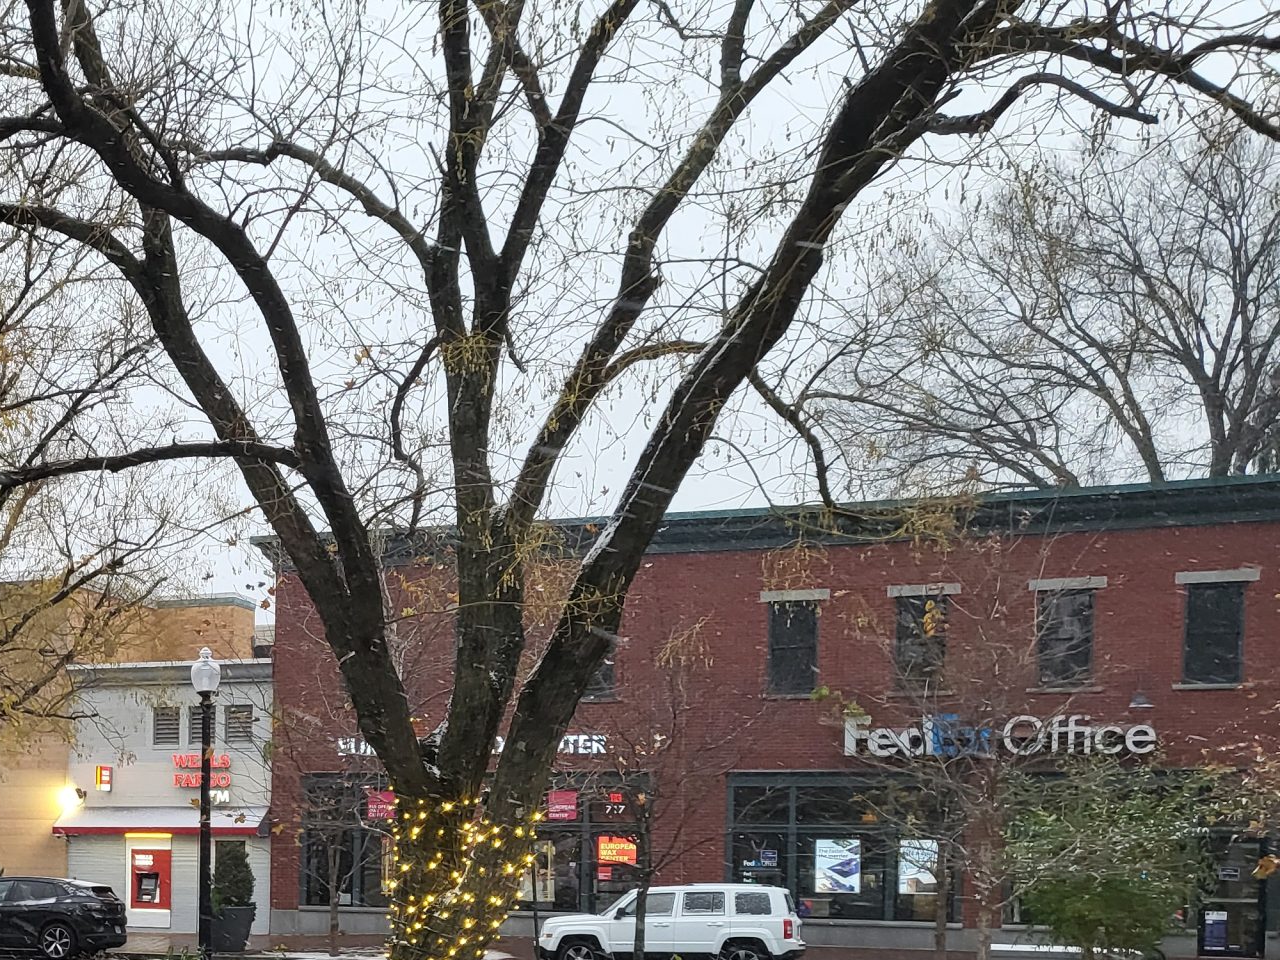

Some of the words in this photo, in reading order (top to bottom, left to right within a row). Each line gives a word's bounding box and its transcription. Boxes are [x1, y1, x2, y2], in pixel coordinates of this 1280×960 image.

[1003, 714, 1157, 755] Office
[172, 753, 231, 769] WELS
[208, 790, 231, 804] TM
